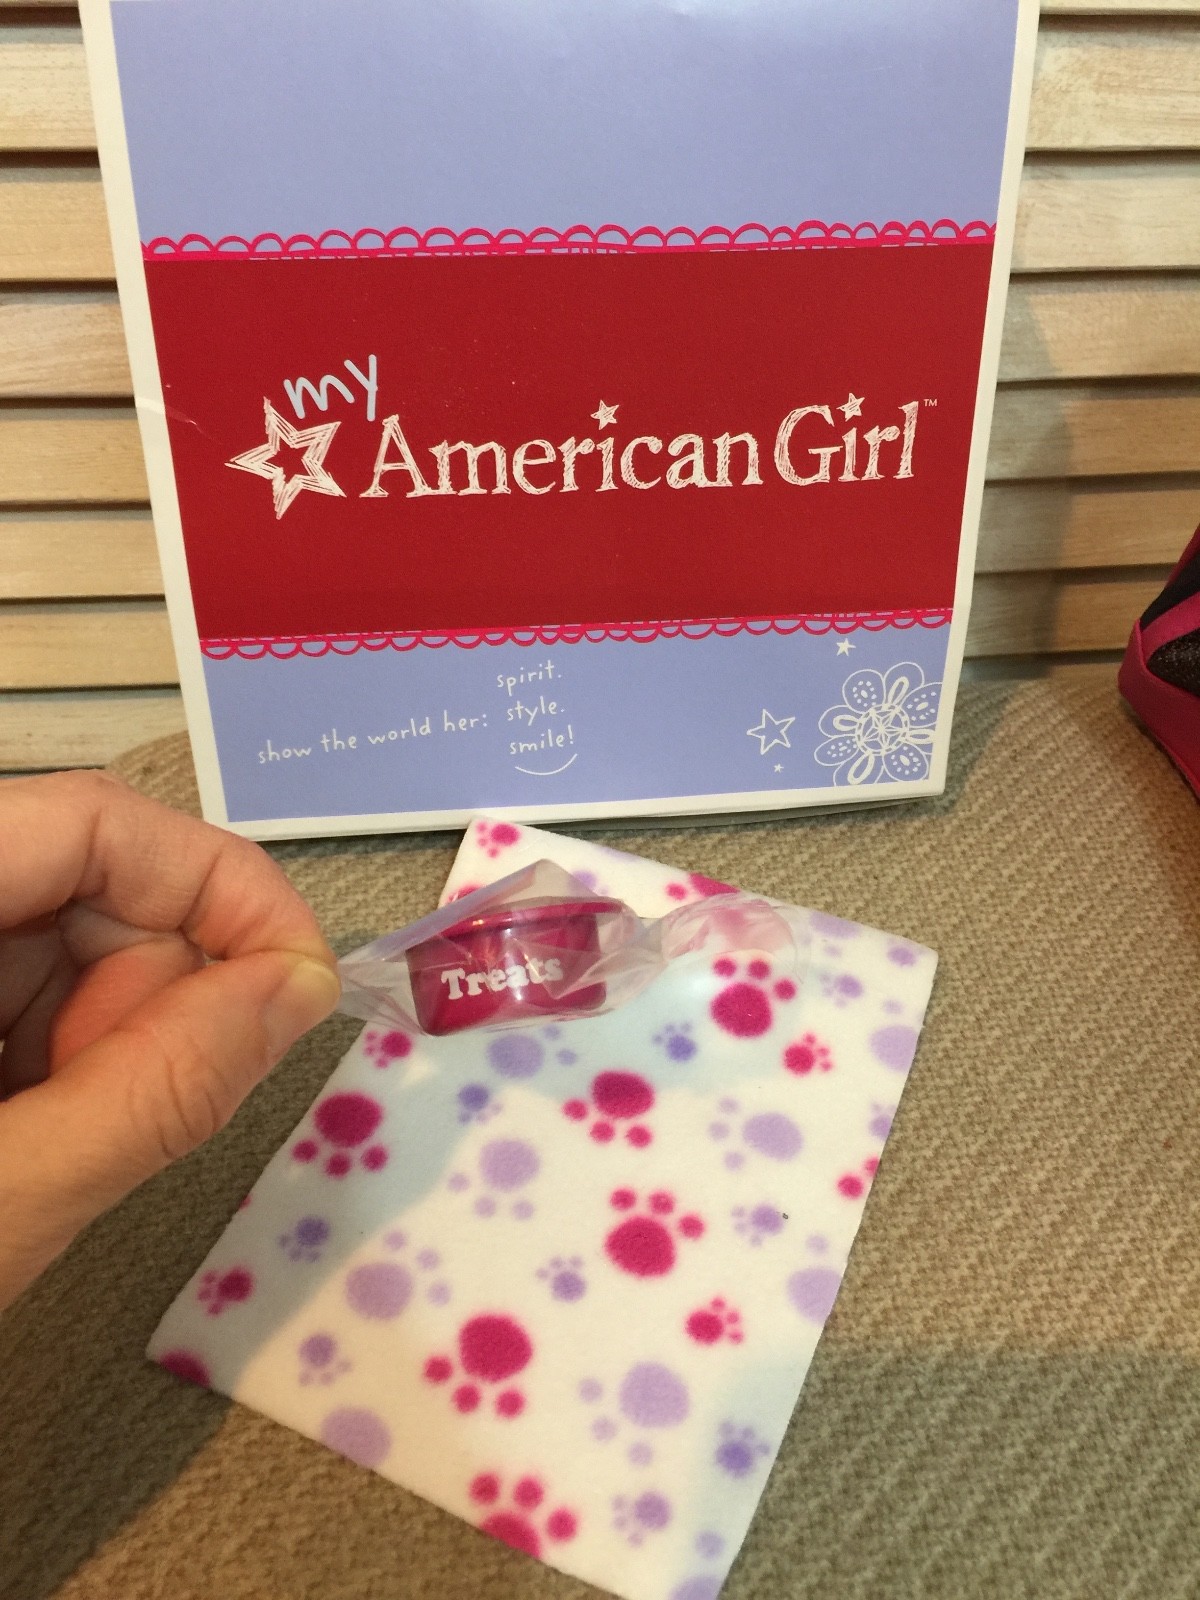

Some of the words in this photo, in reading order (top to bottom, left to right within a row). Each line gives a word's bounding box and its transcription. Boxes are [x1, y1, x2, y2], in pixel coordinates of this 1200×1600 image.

[284, 354, 378, 421] my
[359, 402, 763, 499] American
[774, 393, 920, 486] Girl
[497, 659, 562, 696] spirit.
[507, 696, 565, 726] style.
[258, 740, 312, 764] show
[321, 728, 357, 753] the
[368, 717, 431, 745] world
[444, 710, 488, 732] her:
[509, 725, 575, 755] smile!
[441, 957, 563, 1000] Treats
